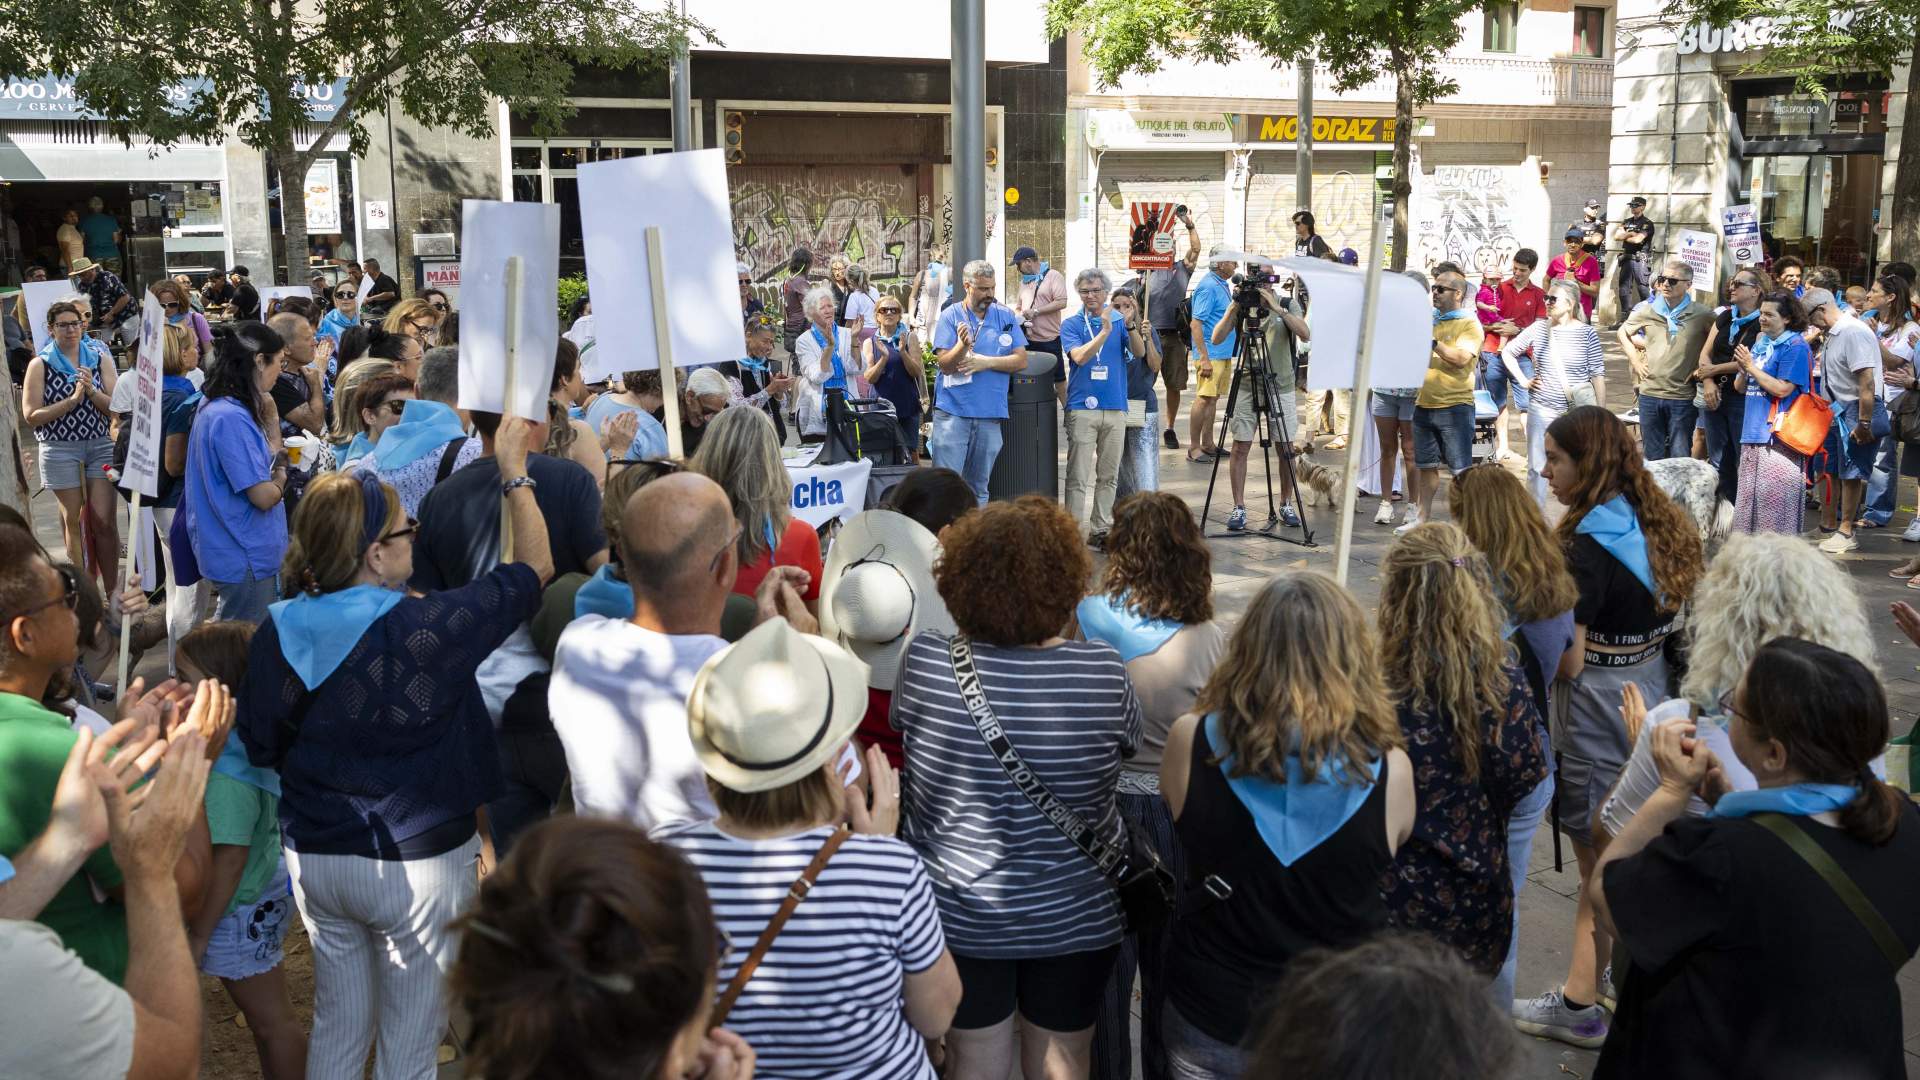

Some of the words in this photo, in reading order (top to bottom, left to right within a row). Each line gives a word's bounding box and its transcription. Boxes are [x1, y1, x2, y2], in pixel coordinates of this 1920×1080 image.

[1174, 121, 1190, 131] DEL
[1193, 120, 1226, 131] GELATO
[1260, 116, 1378, 141] MOORAZ
[426, 271, 460, 281] MAN
[790, 476, 845, 509] cha
[1615, 635, 1619, 644] I
[1622, 634, 1645, 645] FIND.
[1607, 655, 1612, 665] I
[1614, 655, 1628, 665] DO
[1628, 654, 1643, 664] NOT
